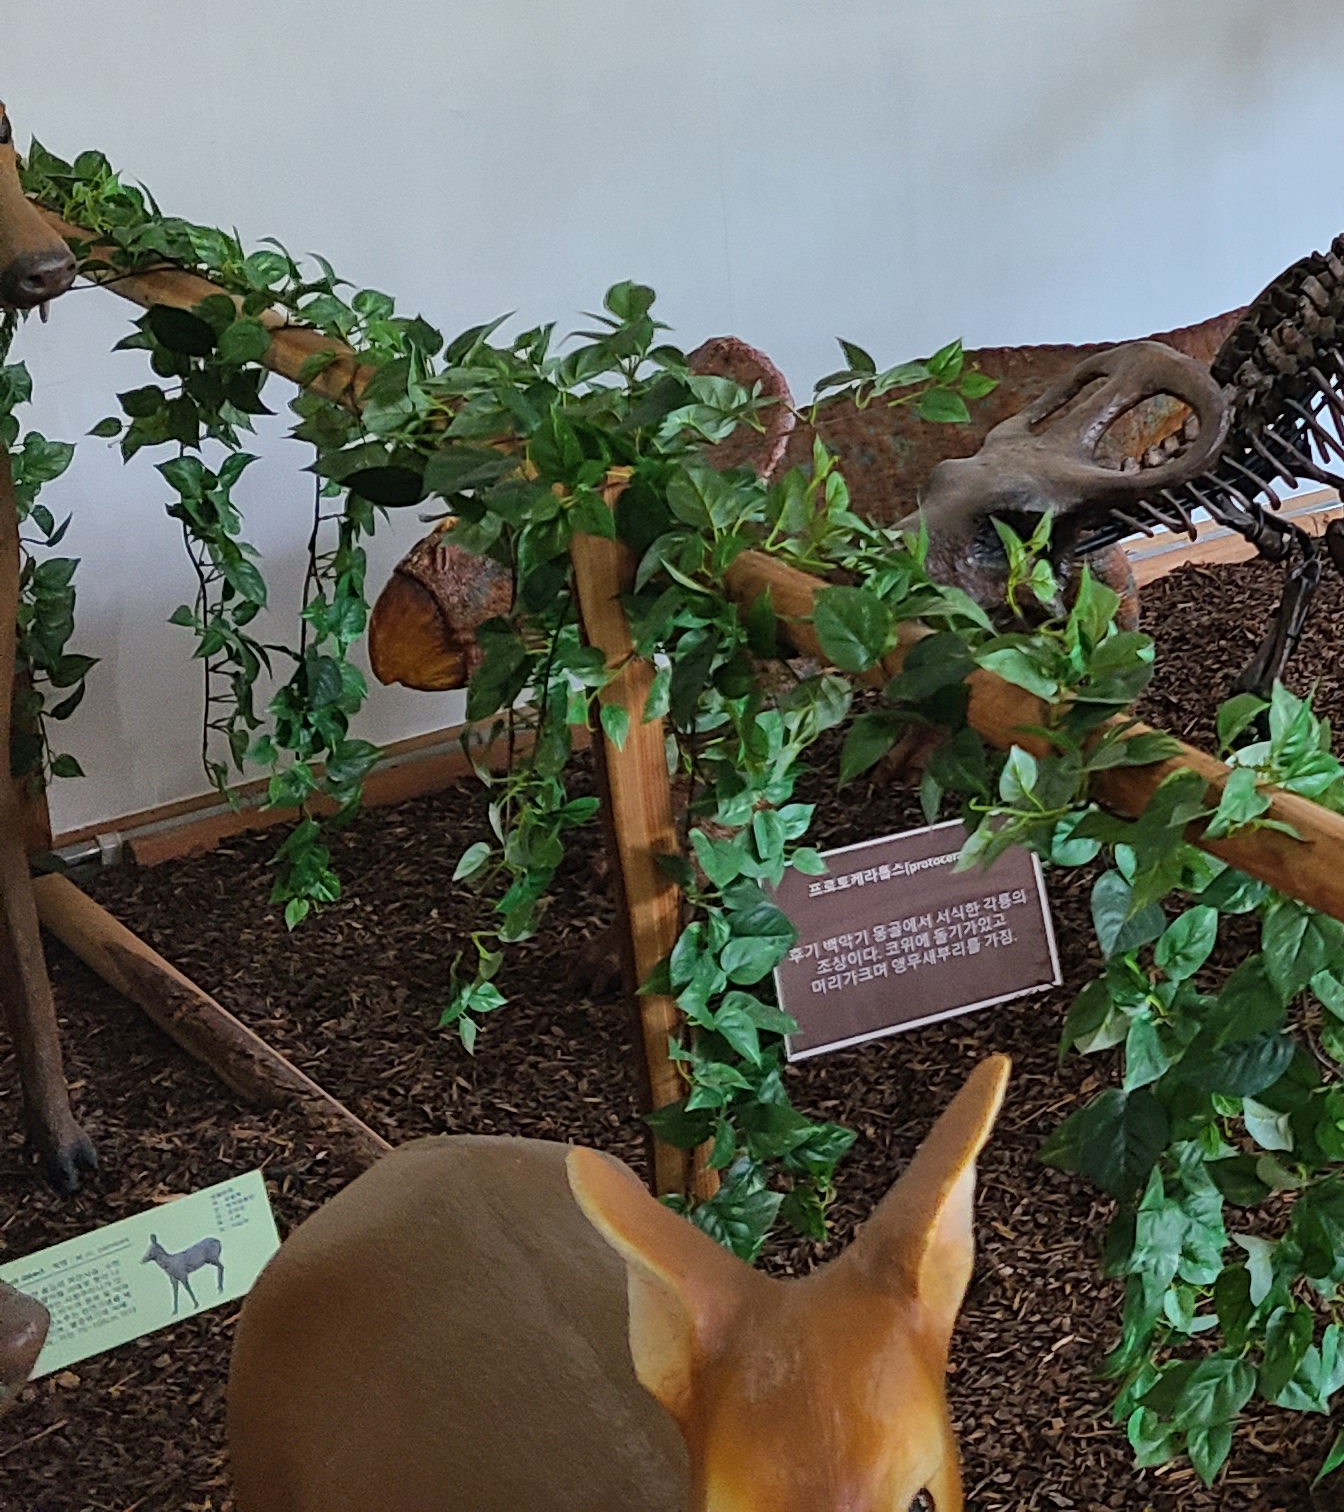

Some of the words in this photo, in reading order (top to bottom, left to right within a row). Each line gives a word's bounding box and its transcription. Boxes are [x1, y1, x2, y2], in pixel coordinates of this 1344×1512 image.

[788, 945, 819, 964] 후기
[823, 929, 869, 953] 백악기
[872, 916, 933, 942] 몽골에서
[936, 904, 980, 925] 서식한
[983, 889, 1026, 912] 각룡의
[816, 947, 882, 976] 조상이다.
[885, 934, 931, 957] 코위에
[933, 913, 1008, 944] 돌기가있고
[811, 962, 889, 995] 머리가크며
[891, 941, 982, 975] 앵무새부리를
